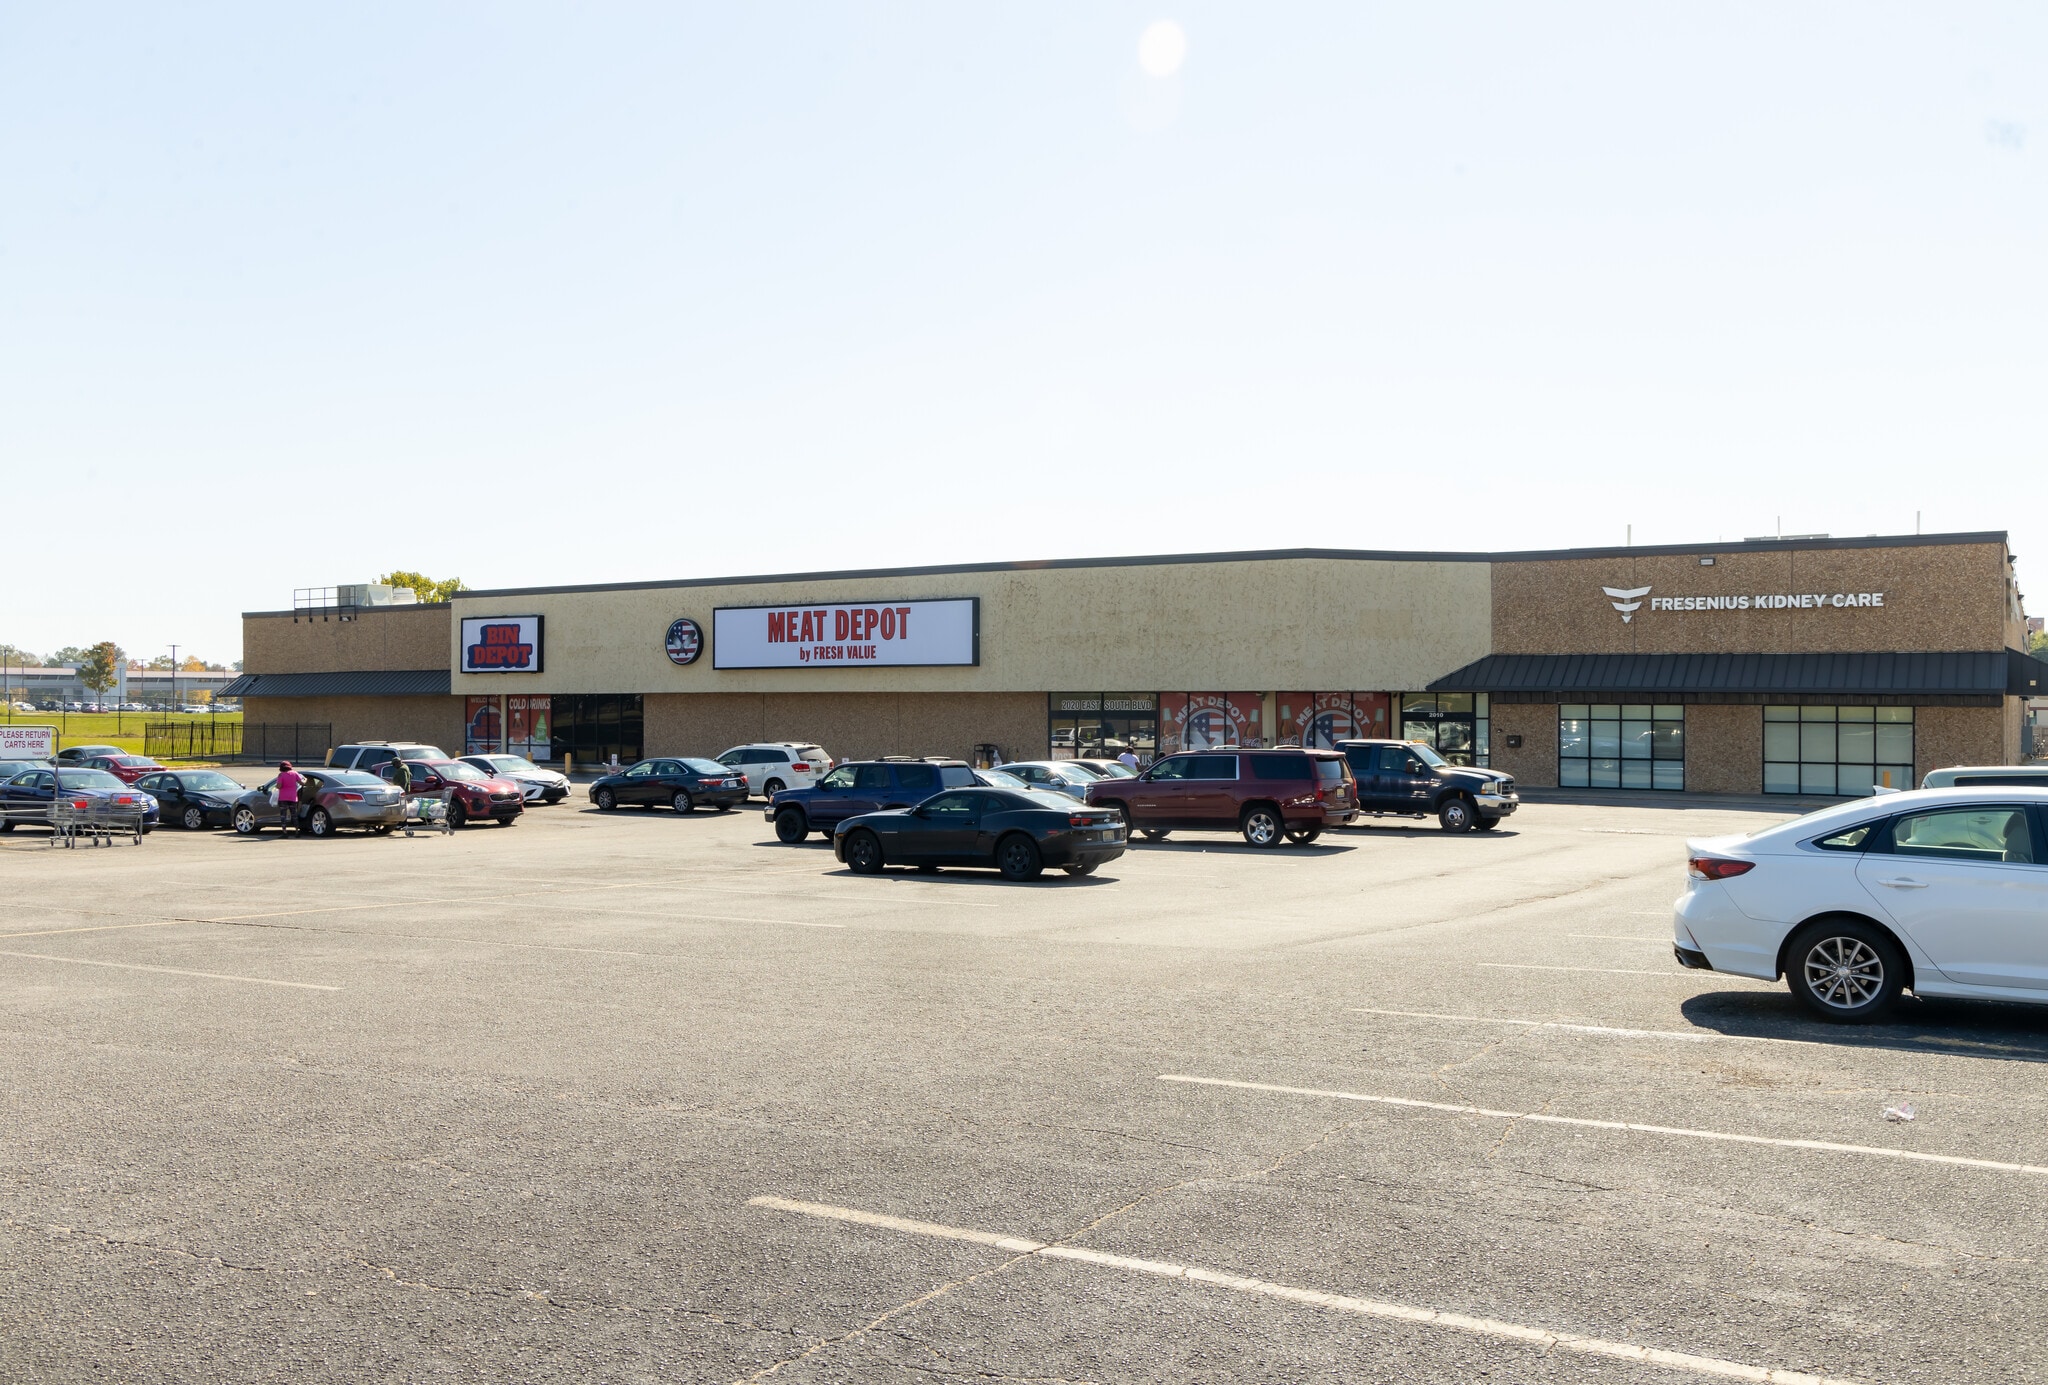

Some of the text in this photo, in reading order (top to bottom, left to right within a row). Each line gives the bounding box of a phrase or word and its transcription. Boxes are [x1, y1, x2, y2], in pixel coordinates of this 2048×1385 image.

[1651, 593, 1884, 610] FRESENIUS KIDNEY CARE
[768, 607, 911, 643] MEAT DEPOT
[486, 626, 519, 645] BIN
[474, 646, 531, 664] DEPOT
[800, 645, 876, 662] by FRESH VALUE
[508, 698, 527, 710] COLD
[1062, 700, 1152, 711] 2020 EAST SOUTH BLVD
[1174, 696, 1247, 725] MEAT DEPOT
[1295, 698, 1328, 727] MEAT
